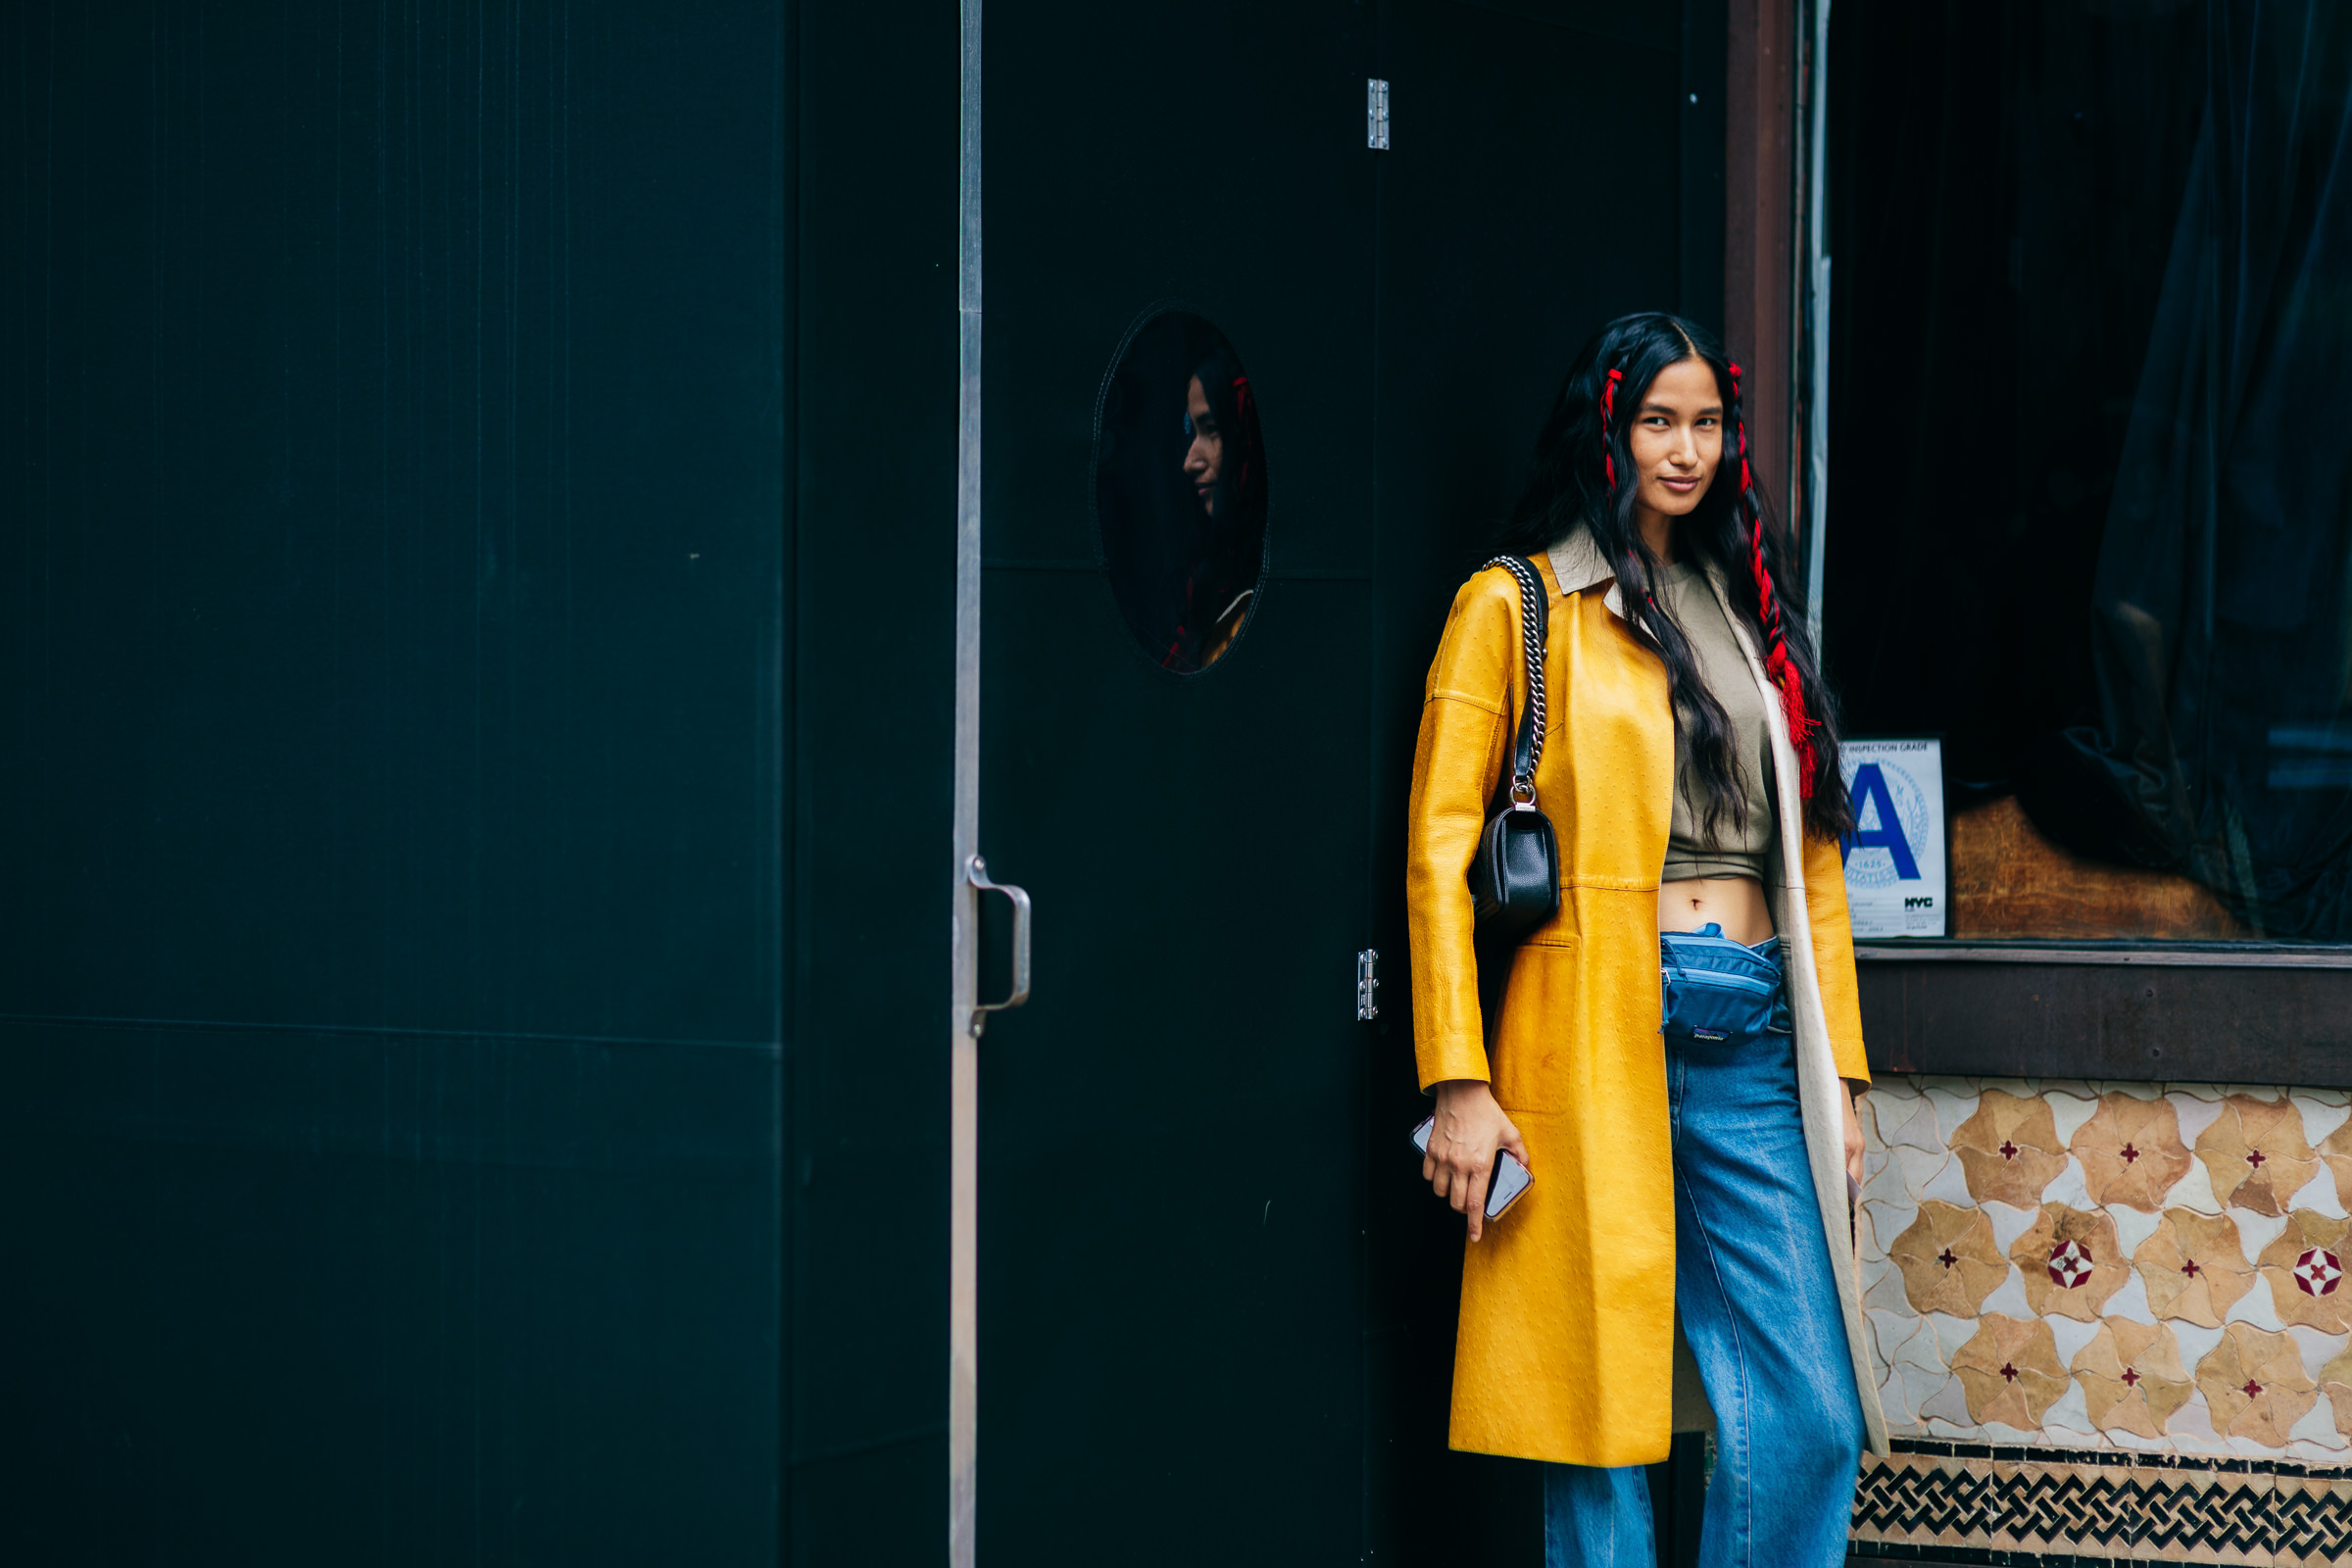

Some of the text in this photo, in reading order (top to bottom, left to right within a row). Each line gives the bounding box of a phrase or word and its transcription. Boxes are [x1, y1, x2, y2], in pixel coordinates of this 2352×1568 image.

[1849, 743, 1896, 753] INSPECTION
[1900, 742, 1928, 753] GRADE
[1839, 763, 1921, 879] A
[1904, 897, 1933, 907] NYC
